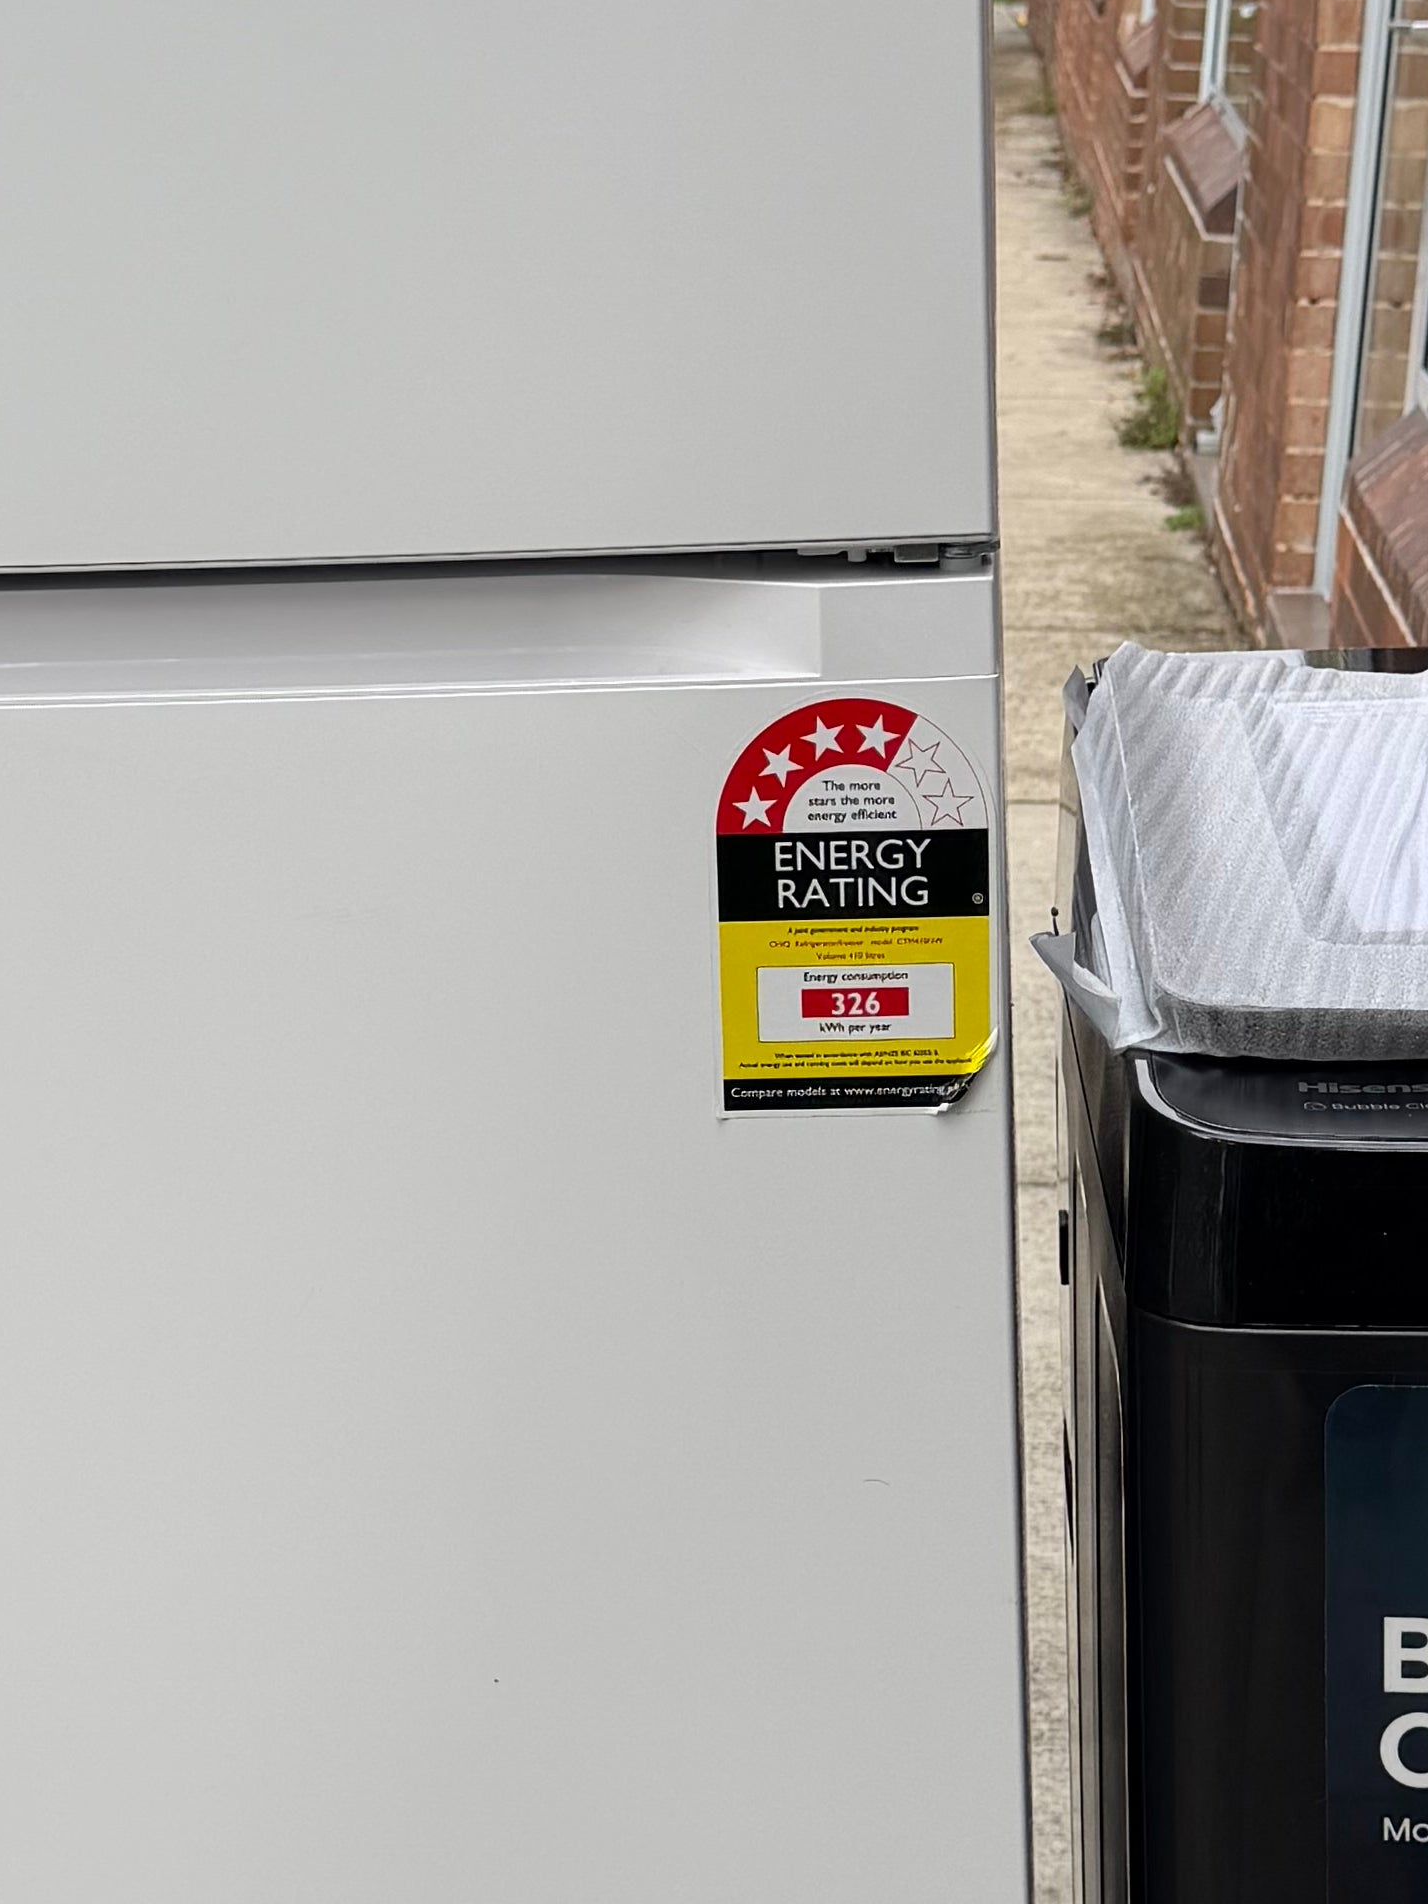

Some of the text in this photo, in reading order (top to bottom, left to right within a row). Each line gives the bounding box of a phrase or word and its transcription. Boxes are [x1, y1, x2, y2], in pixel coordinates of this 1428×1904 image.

[822, 780, 881, 791] The more
[808, 794, 895, 806] stars the more
[807, 808, 898, 823] energy efficient
[774, 837, 932, 872] ENERGY
[777, 875, 929, 908] RATING
[803, 971, 908, 984] Energy consumption
[831, 992, 881, 1016] 326
[819, 1023, 892, 1035] kWh per year
[731, 1087, 783, 1099] Compare
[787, 1085, 826, 1096] models
[830, 1087, 841, 1096] at
[1332, 1102, 1401, 1111] Bubble
